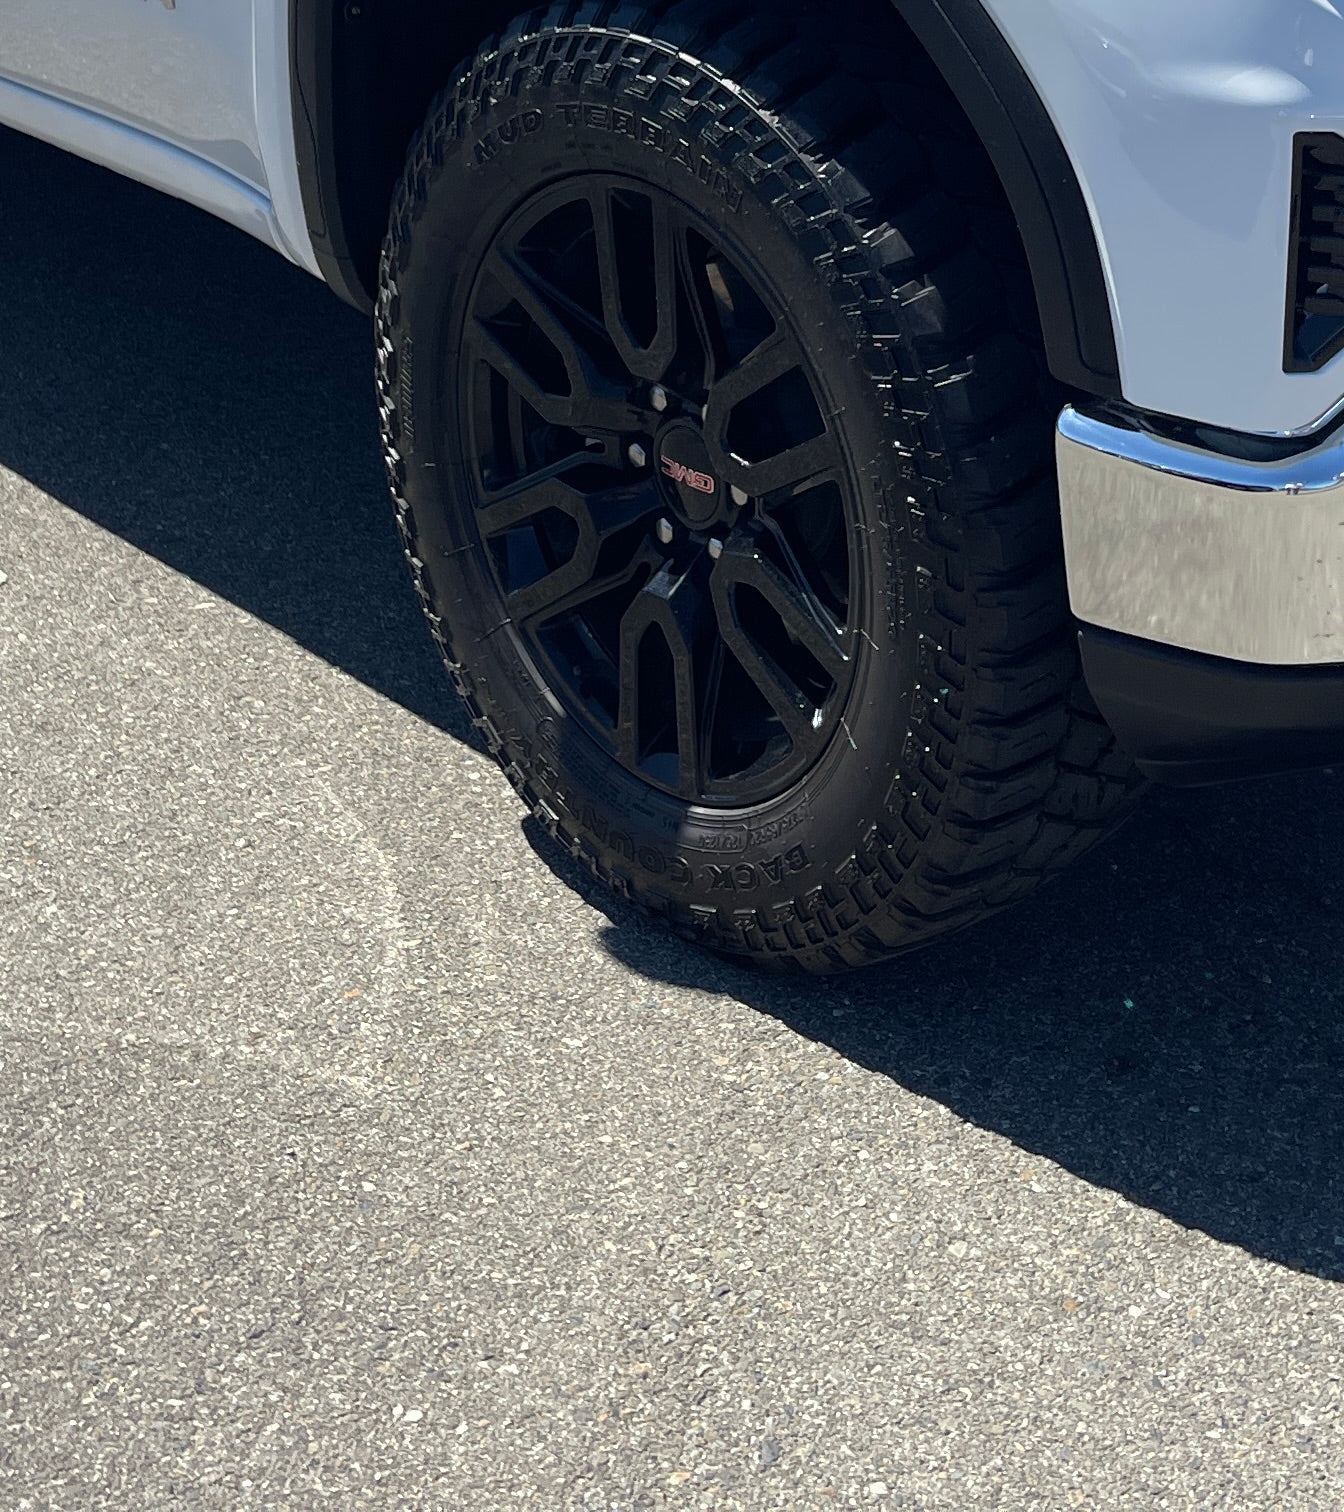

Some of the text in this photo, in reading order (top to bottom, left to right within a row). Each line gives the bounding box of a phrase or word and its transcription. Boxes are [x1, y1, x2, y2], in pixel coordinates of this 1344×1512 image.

[473, 100, 744, 214] MUD TERRAIN
[660, 455, 715, 494] GMC
[705, 843, 813, 893] BACK
